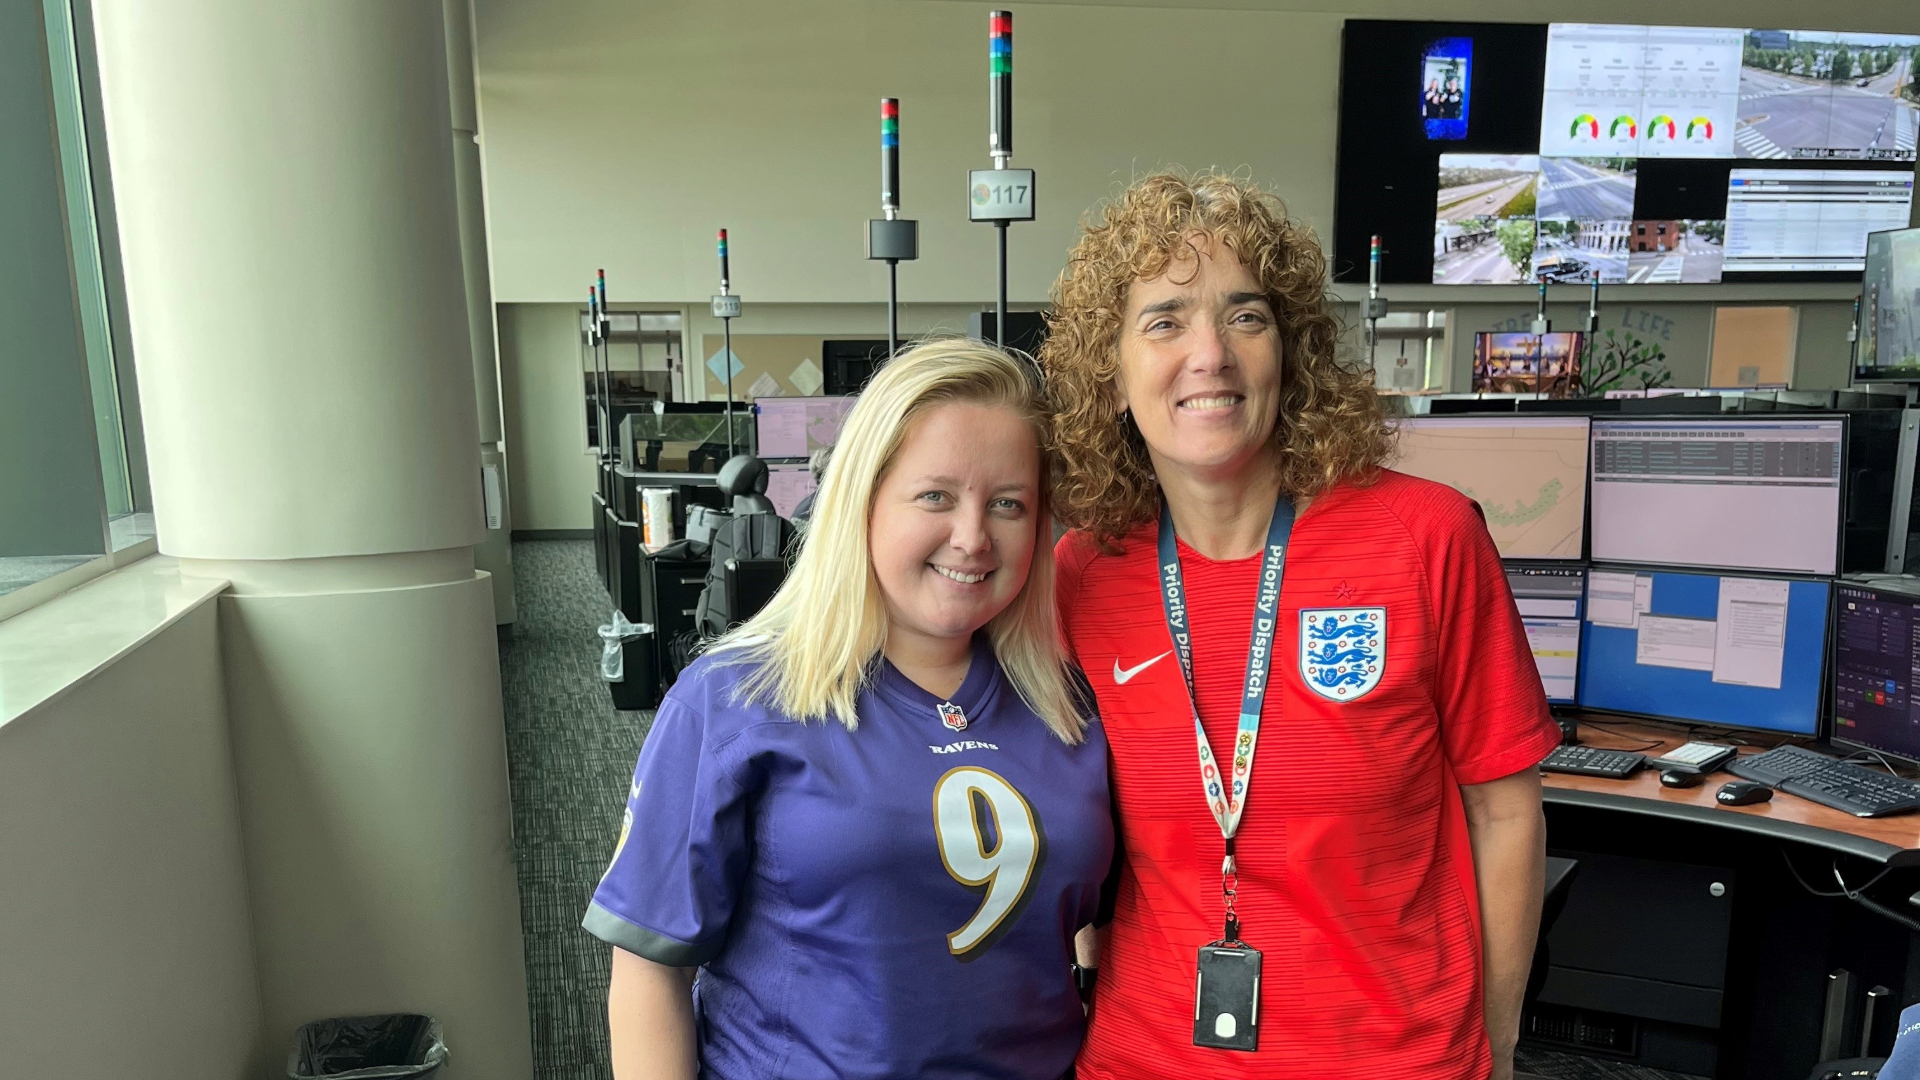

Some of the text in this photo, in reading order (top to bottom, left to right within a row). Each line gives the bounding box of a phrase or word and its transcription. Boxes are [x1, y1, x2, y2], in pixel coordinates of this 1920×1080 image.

[993, 185, 1028, 204] 117
[724, 302, 739, 311] 119
[1492, 312, 1533, 331] TRE
[1622, 306, 1675, 341] LIFE
[1163, 563, 1185, 629] Priority
[1248, 545, 1284, 699] Priority Dispatch
[945, 713, 966, 727] NFL
[928, 741, 999, 754] RAVENS
[933, 766, 1040, 956] 9
